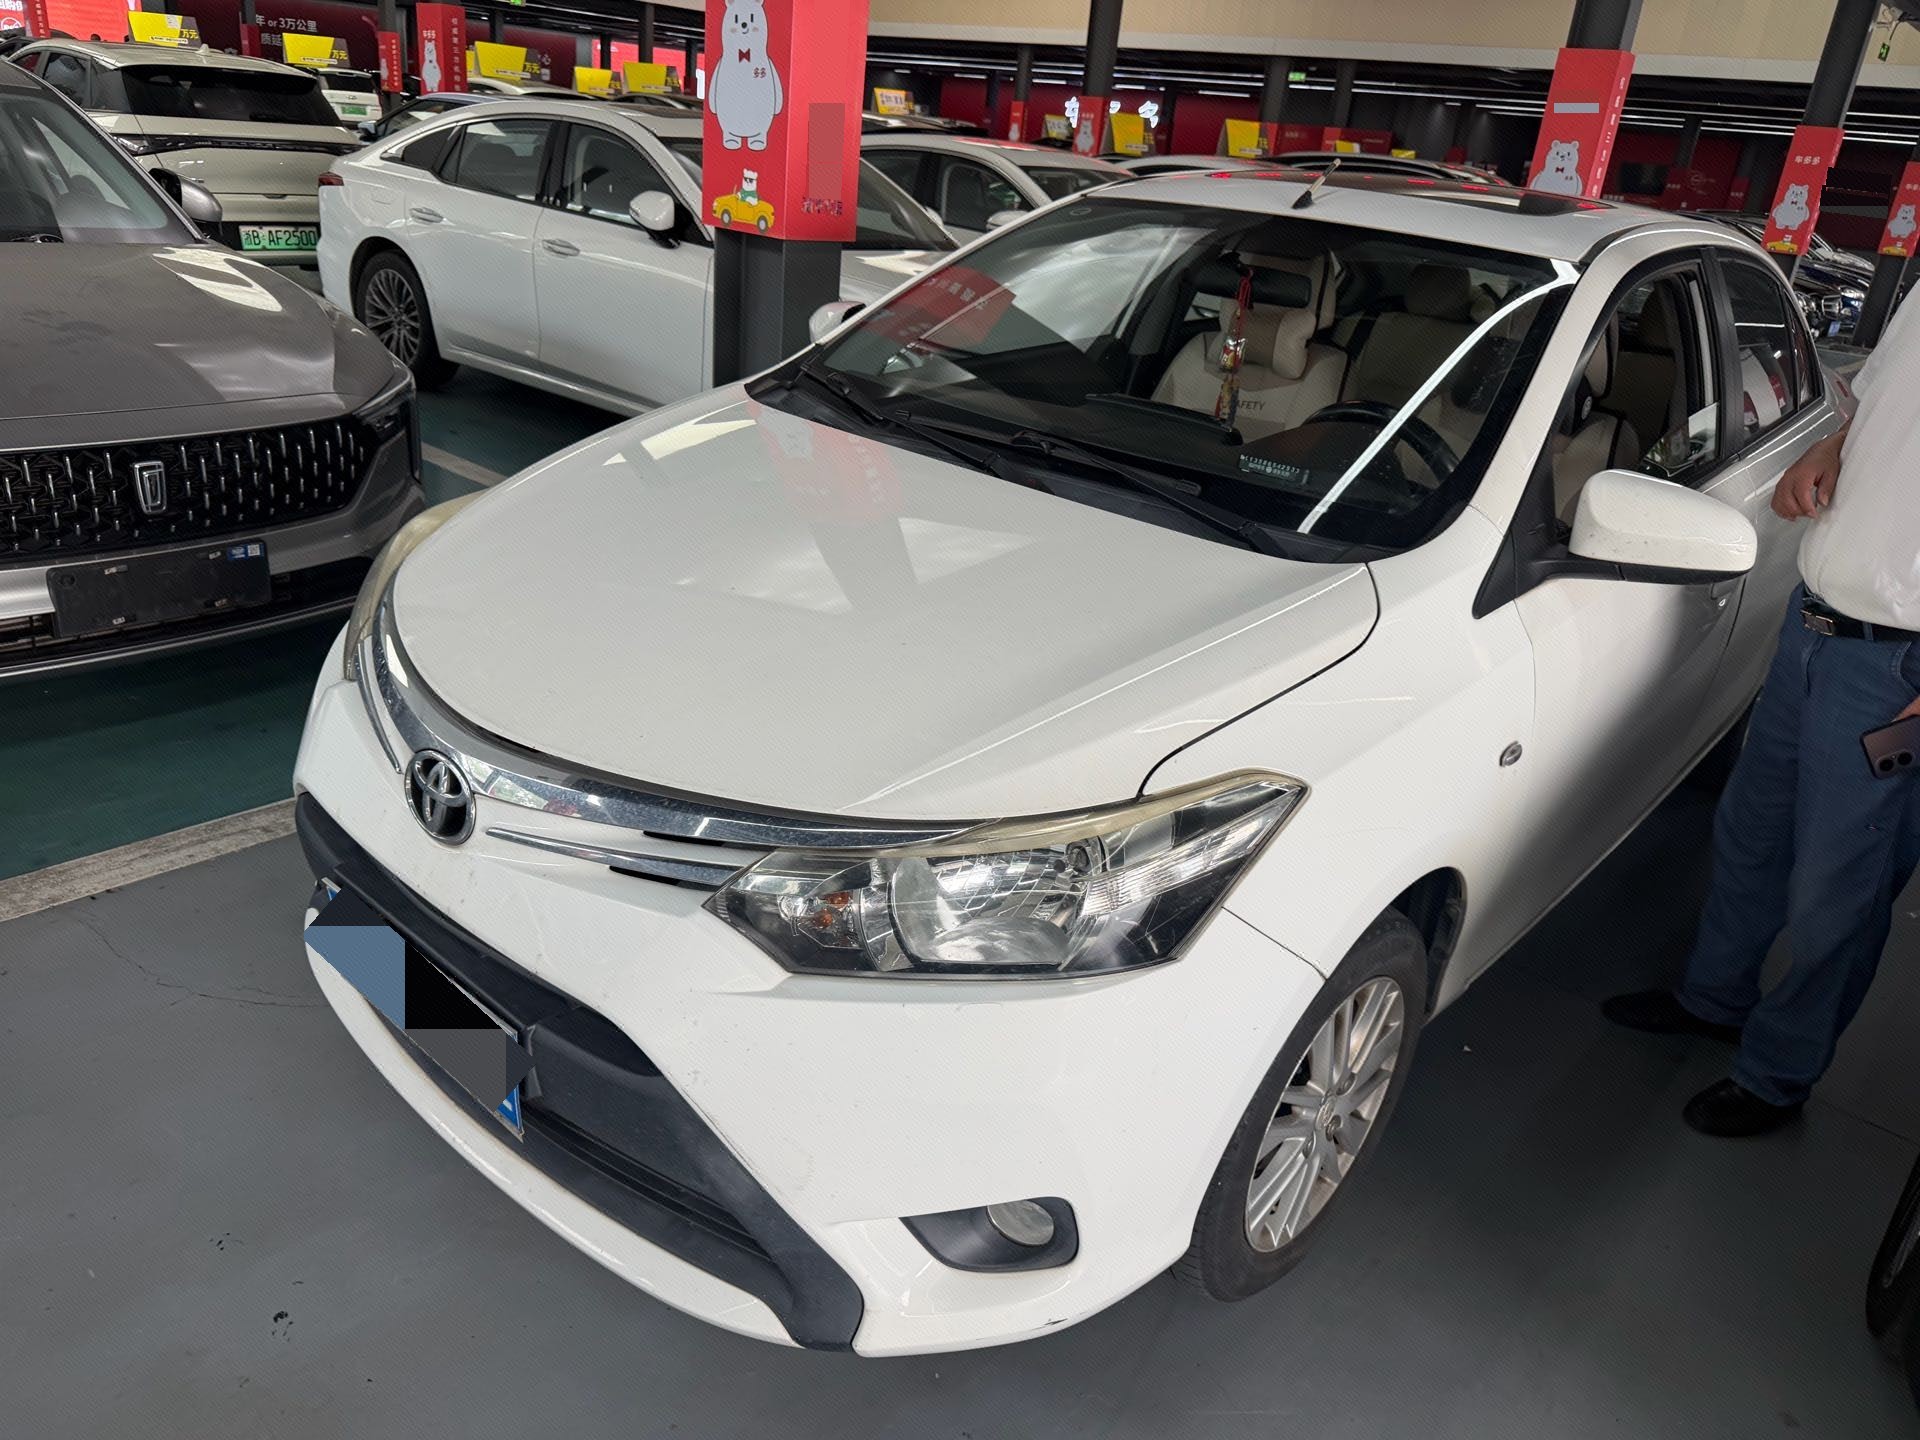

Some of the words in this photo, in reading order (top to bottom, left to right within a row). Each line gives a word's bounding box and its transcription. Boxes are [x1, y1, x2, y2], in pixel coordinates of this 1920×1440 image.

[279, 17, 318, 33] 3万公里
[181, 29, 199, 39] 万元
[331, 49, 348, 60] 万元
